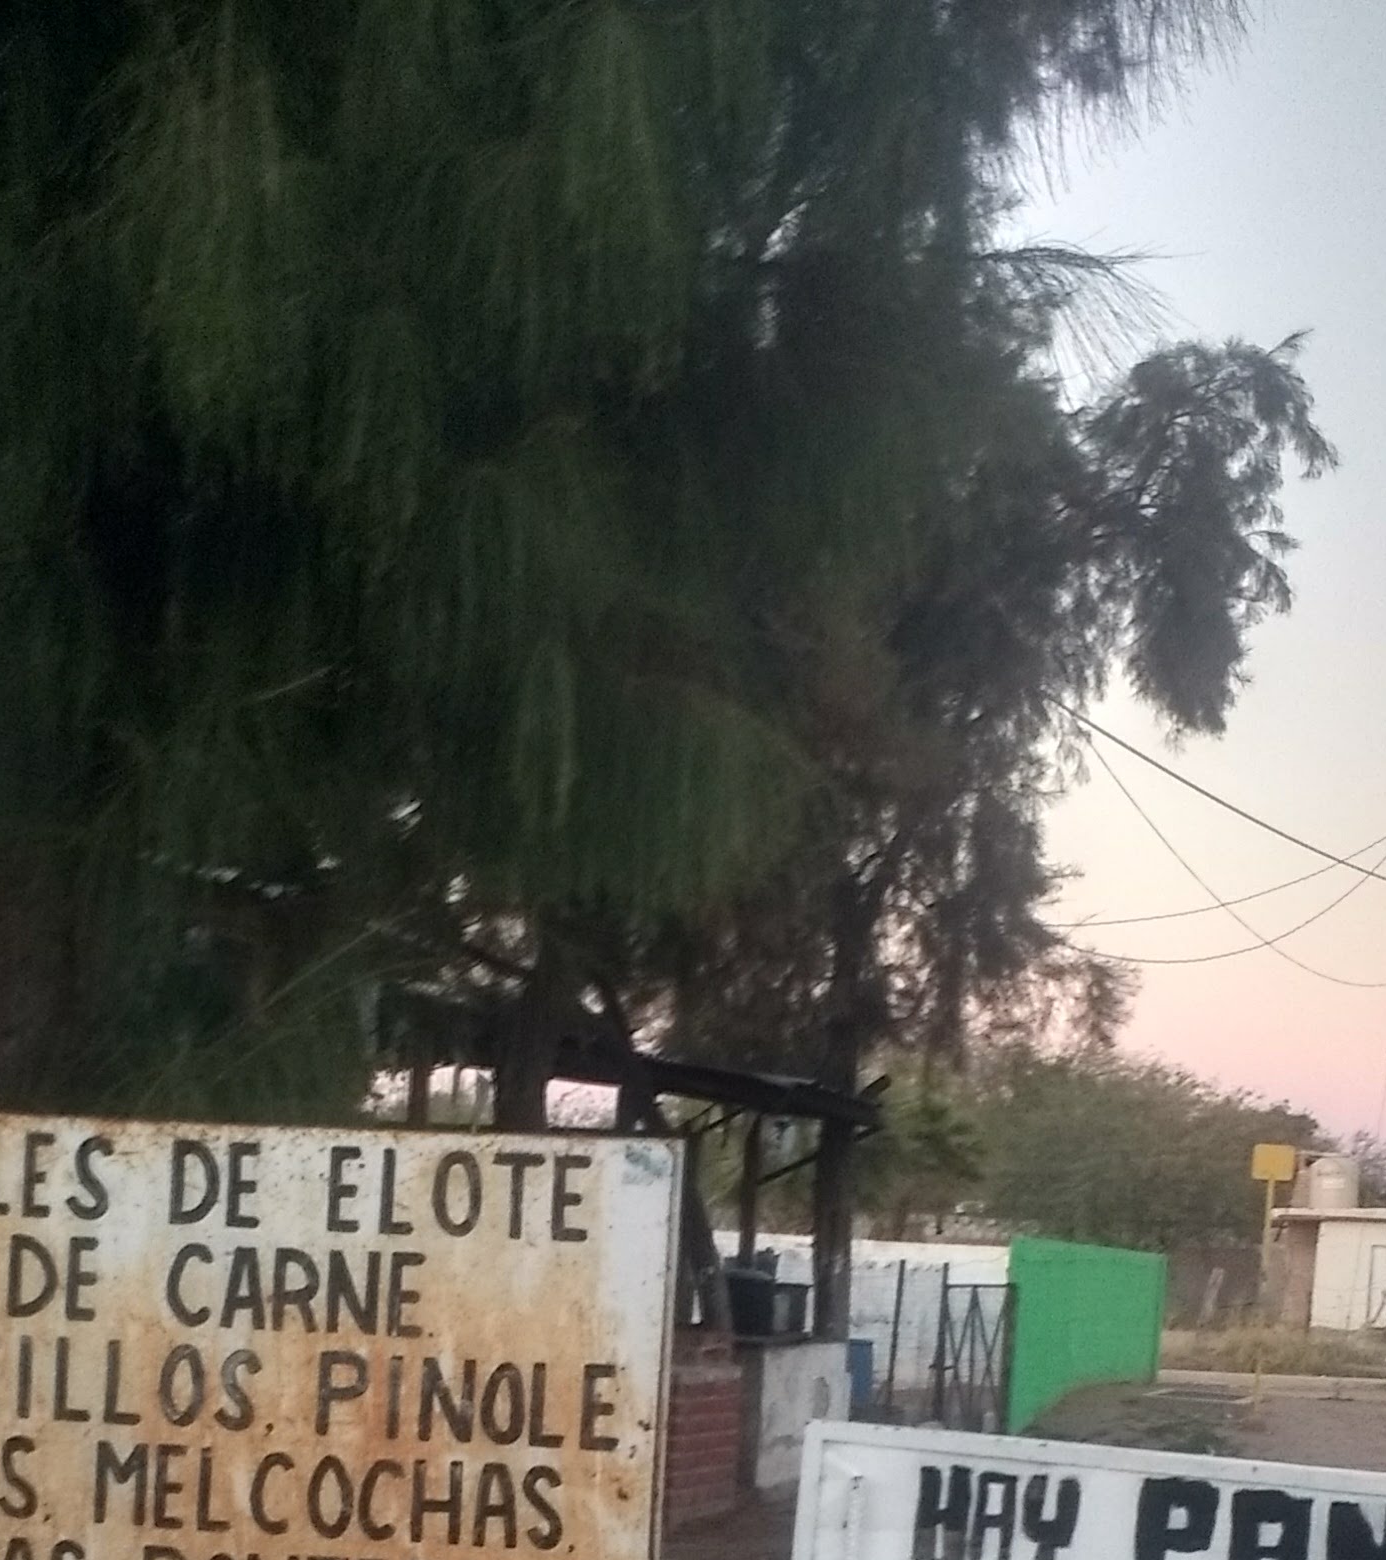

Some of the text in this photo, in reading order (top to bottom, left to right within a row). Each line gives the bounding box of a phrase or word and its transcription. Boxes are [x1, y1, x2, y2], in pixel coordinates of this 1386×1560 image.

[168, 1139, 262, 1229] DE
[326, 1146, 592, 1242] ELOTE
[6, 1234, 100, 1322] DE
[315, 1350, 637, 1459] PINOLE,
